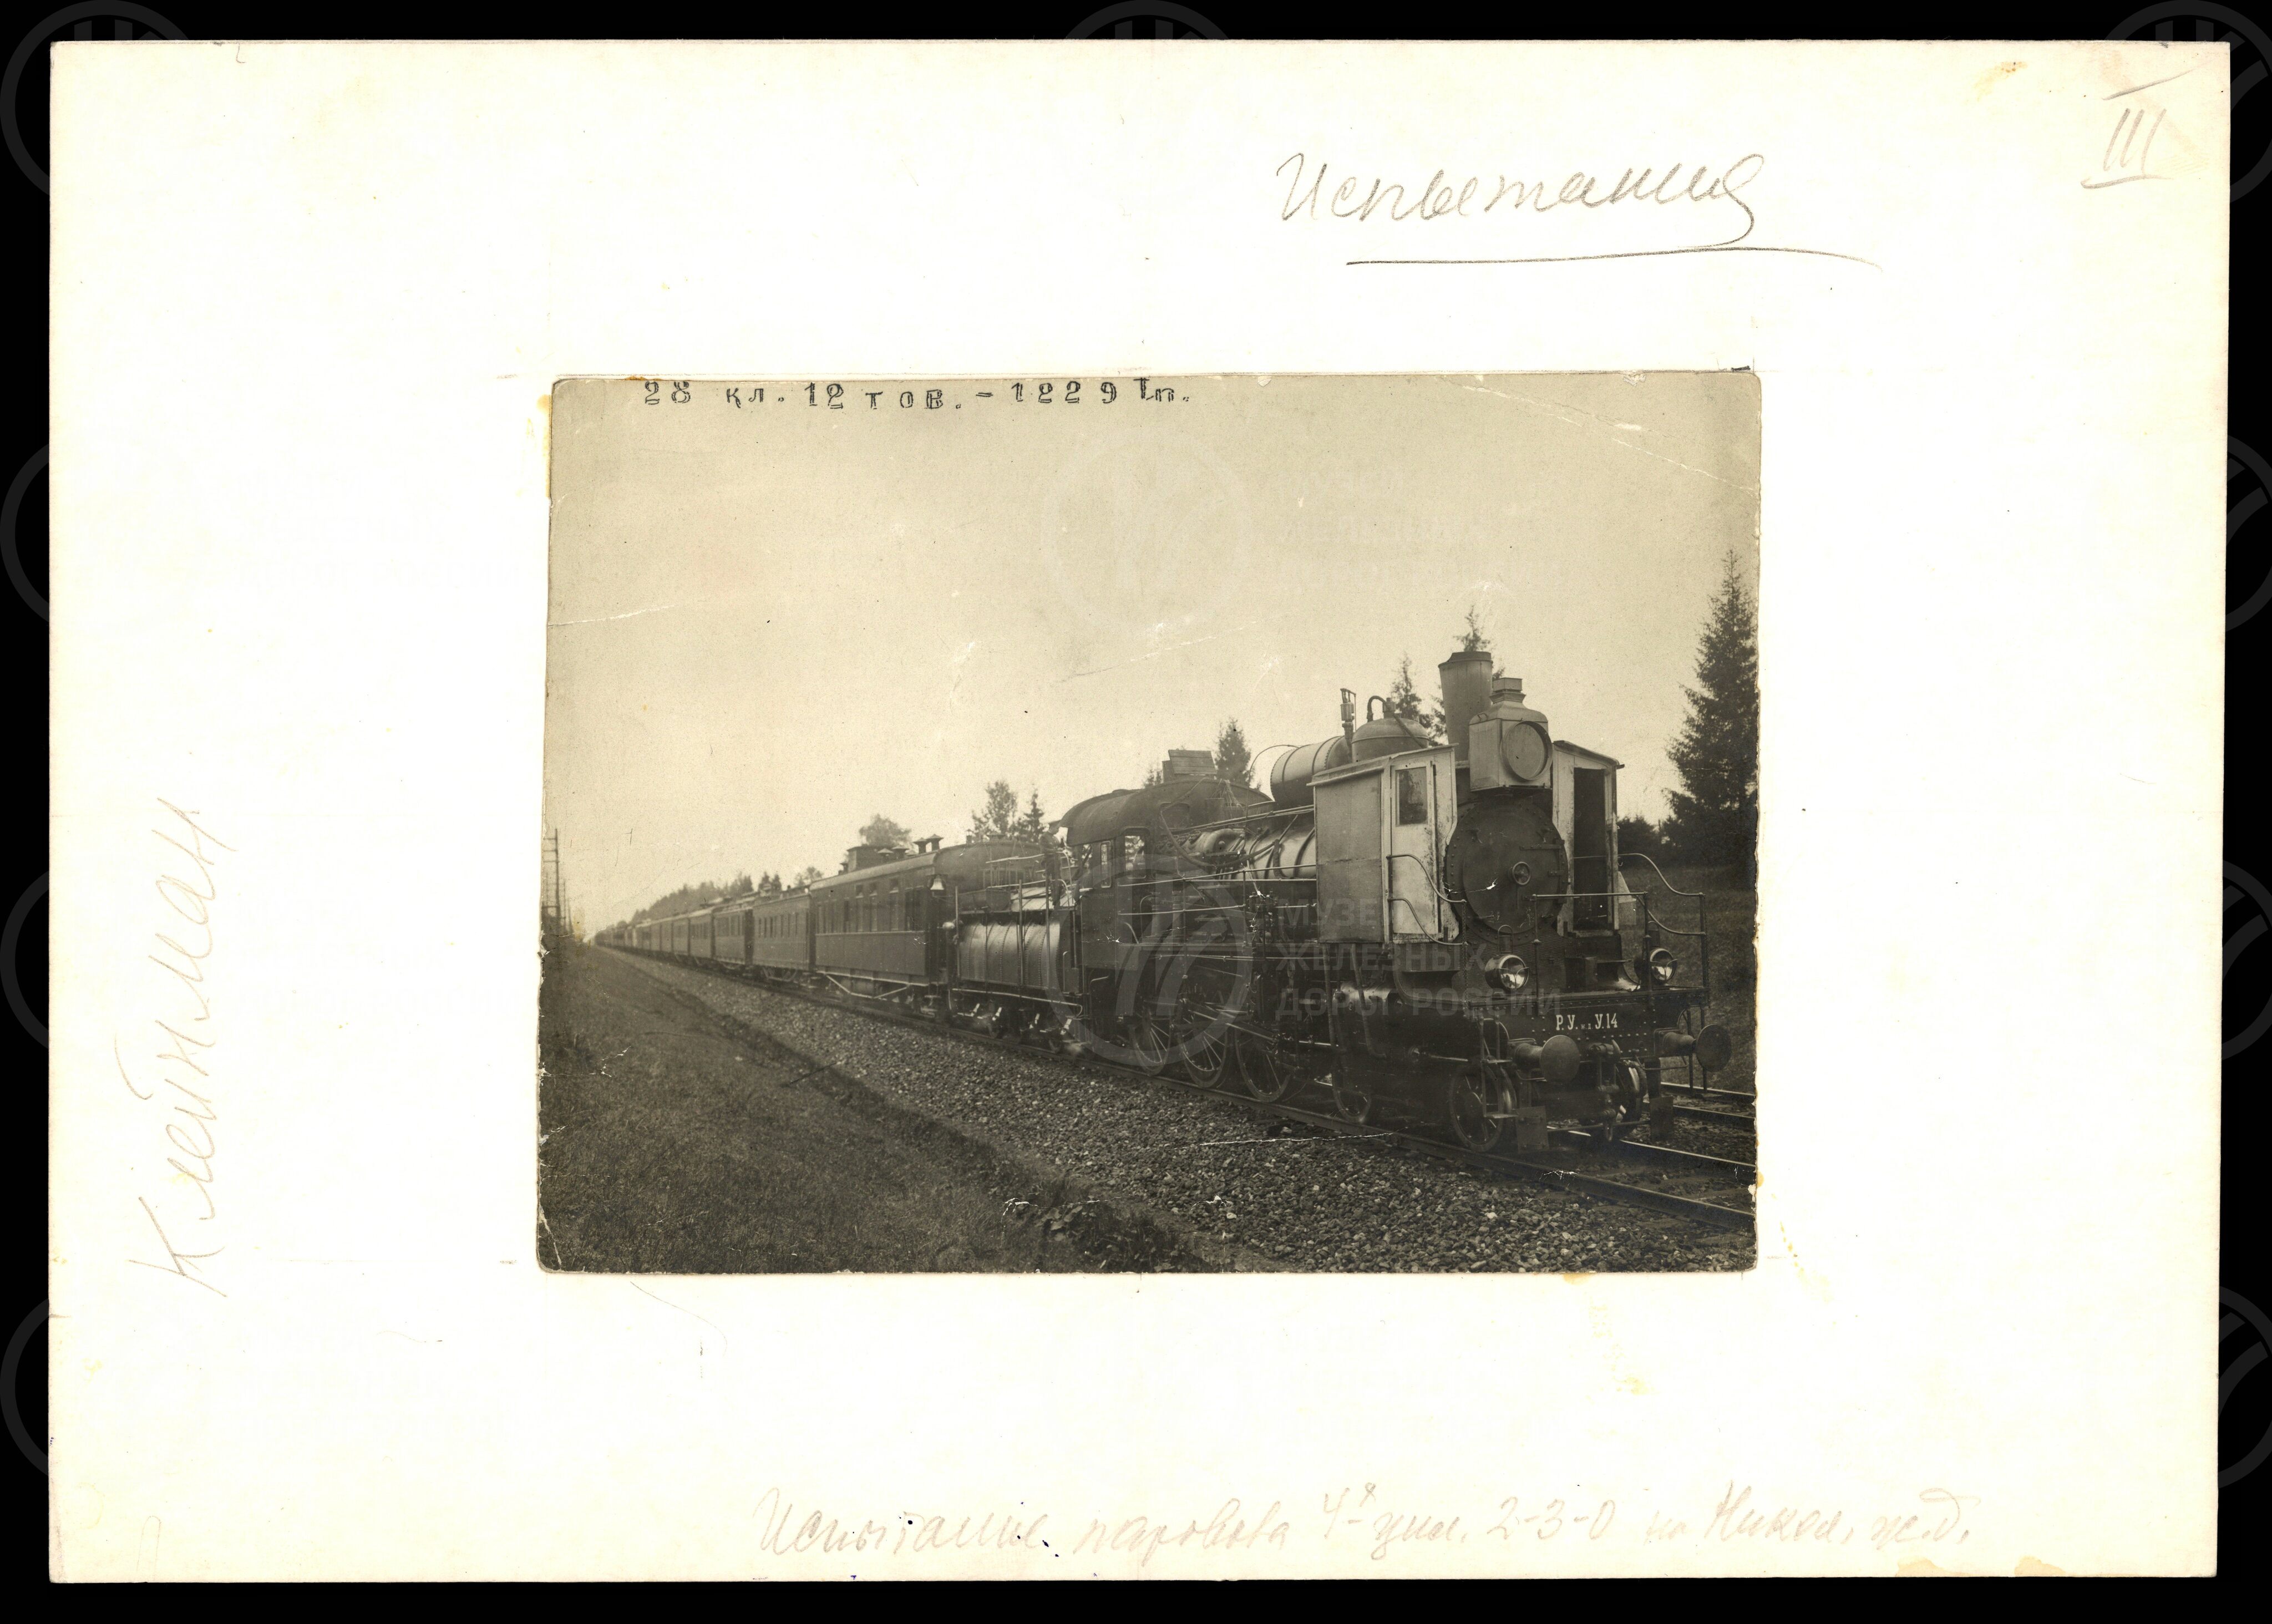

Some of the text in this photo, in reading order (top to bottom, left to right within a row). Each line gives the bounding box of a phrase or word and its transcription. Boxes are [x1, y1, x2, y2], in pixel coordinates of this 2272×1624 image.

[1276, 152, 1765, 248] Испытания
[645, 381, 691, 404] 28
[804, 382, 844, 409] 12
[1011, 380, 1118, 404] 1229
[1486, 1496, 1617, 1541] 2-3-0
